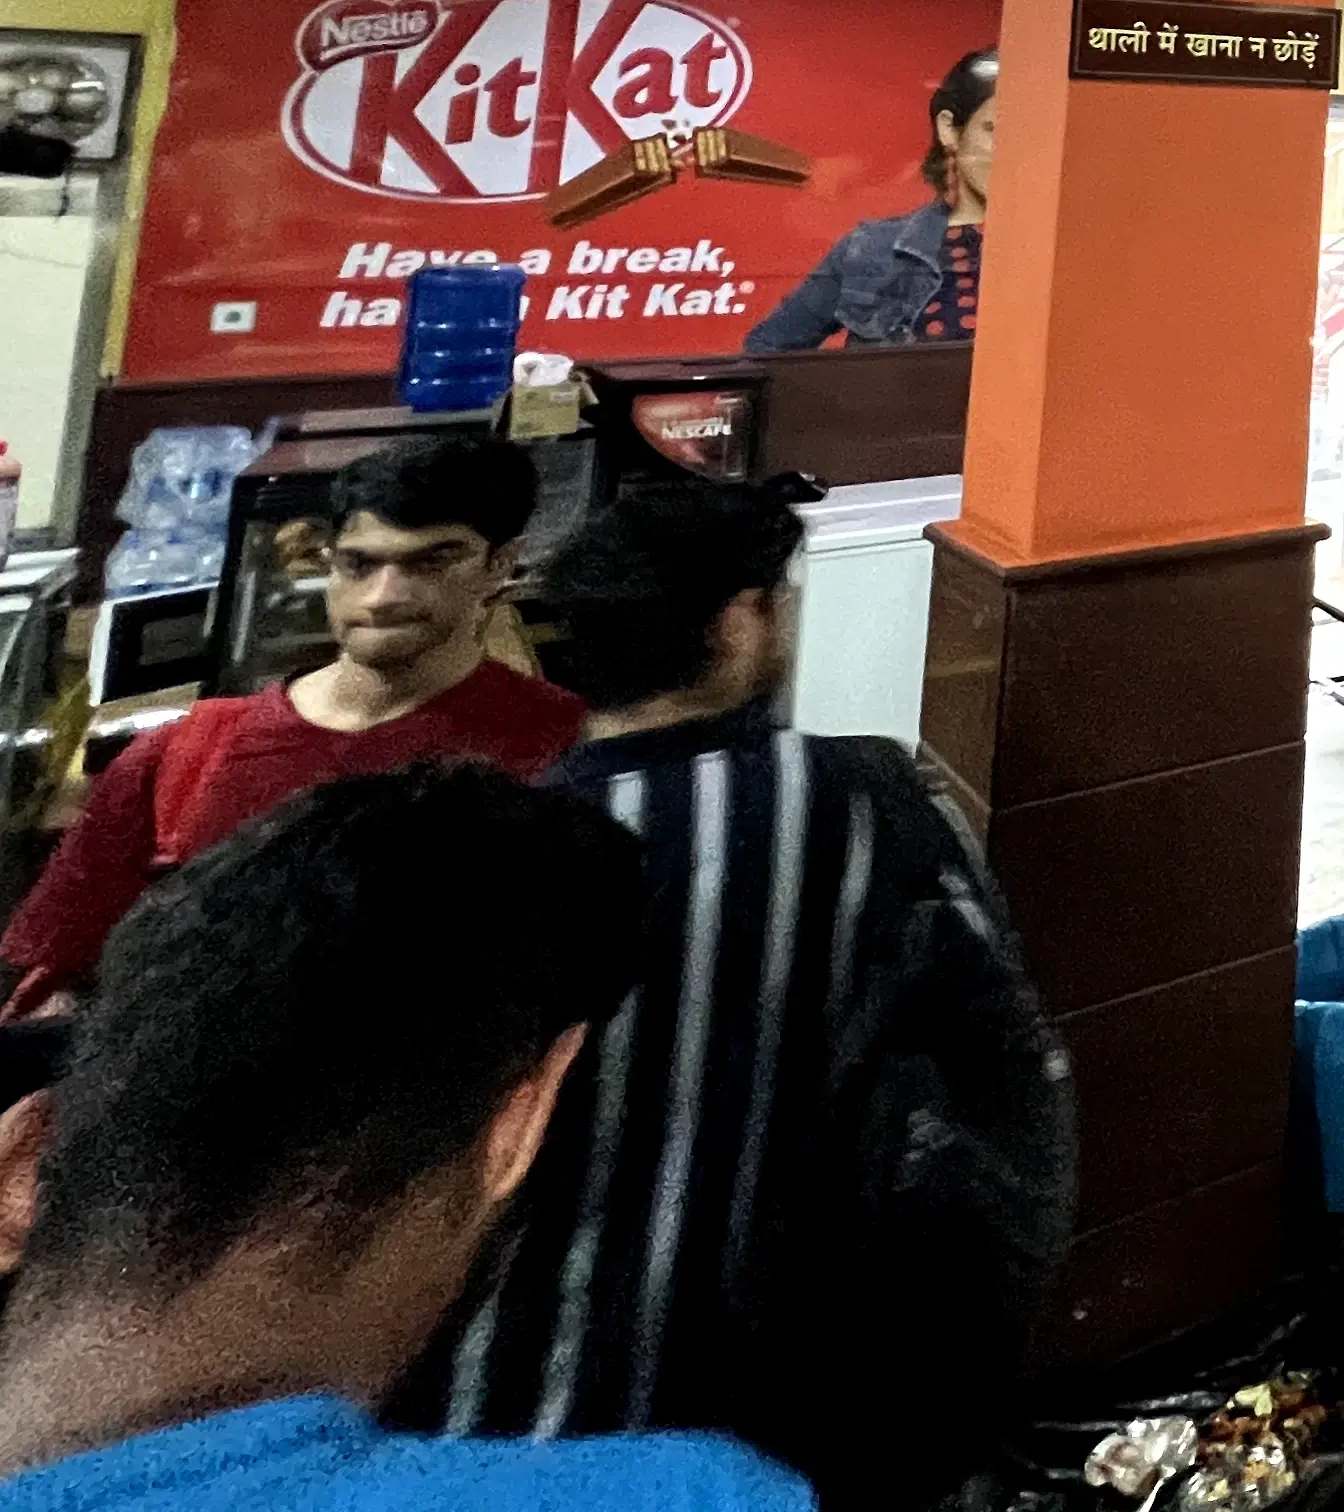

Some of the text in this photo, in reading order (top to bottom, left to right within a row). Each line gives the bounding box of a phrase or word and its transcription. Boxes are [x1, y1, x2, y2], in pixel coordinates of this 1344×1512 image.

[1088, 21, 1151, 54] थाली
[1157, 22, 1180, 55] में
[1184, 32, 1244, 59] खाना
[1248, 36, 1267, 60] न
[518, 246, 551, 276] a
[567, 239, 736, 277] break,
[545, 283, 632, 321] Kit
